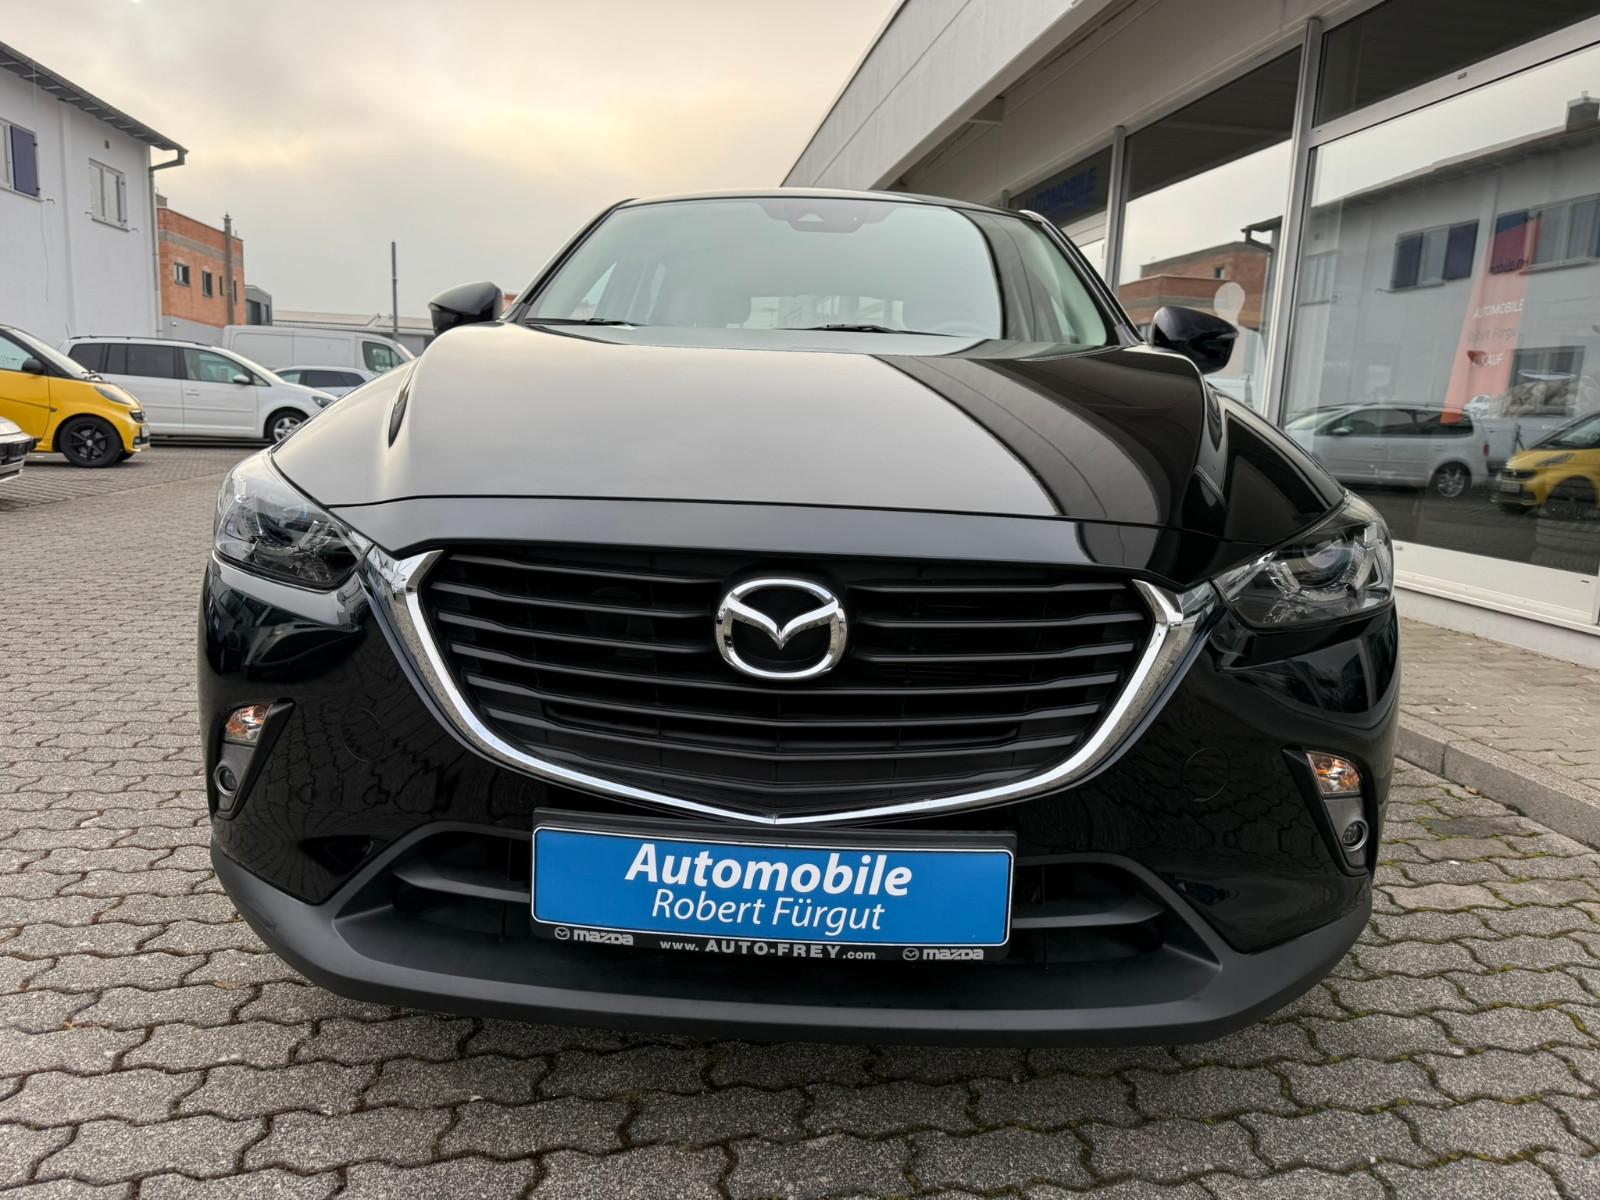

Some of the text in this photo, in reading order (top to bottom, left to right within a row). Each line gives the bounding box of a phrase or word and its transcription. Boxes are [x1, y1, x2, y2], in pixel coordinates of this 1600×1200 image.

[624, 843, 913, 897] Automobile
[652, 888, 886, 937] Robert Fürgut
[659, 940, 700, 952] www.
